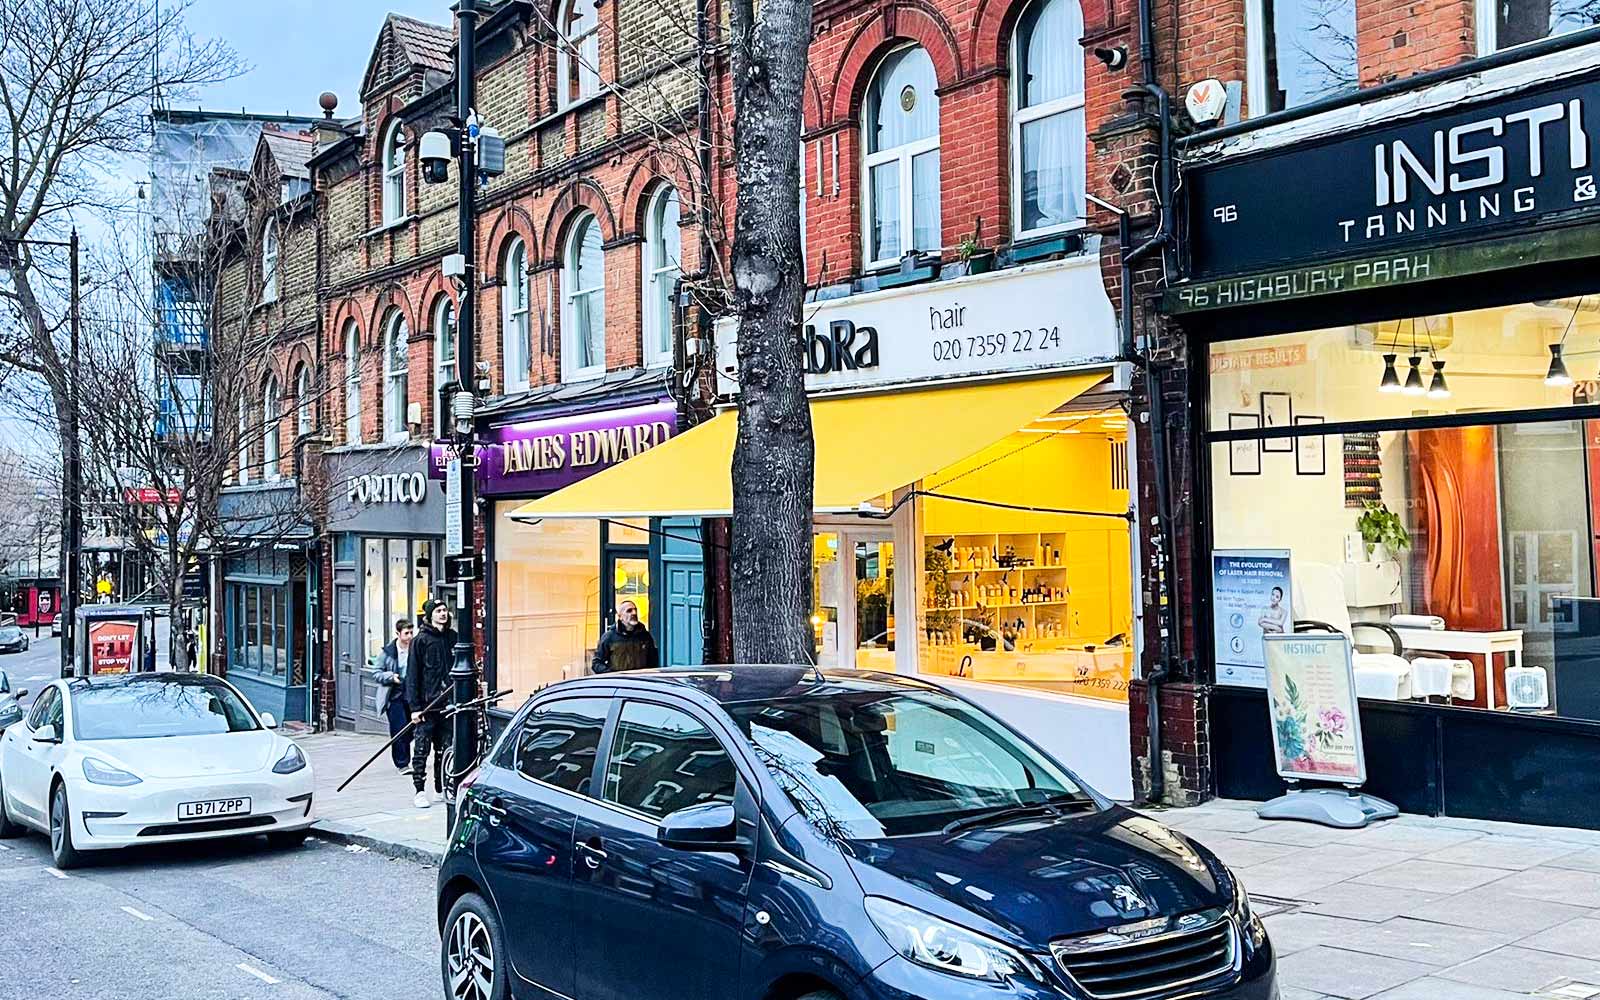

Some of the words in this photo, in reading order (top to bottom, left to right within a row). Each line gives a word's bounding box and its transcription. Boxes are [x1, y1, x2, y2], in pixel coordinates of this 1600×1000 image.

[1374, 98, 1587, 207] INSTI
[1213, 204, 1238, 223] 96
[1338, 185, 1535, 243] TANNING
[1574, 174, 1598, 202] &
[1178, 286, 1209, 308] 96
[1216, 267, 1345, 305] HIGHBURY
[929, 301, 967, 331] hair
[932, 337, 962, 362] 020
[967, 332, 1007, 358] 7359
[1012, 328, 1033, 353] 22
[1039, 325, 1061, 349] 24
[1255, 348, 1301, 366] RESULTS
[502, 433, 567, 476] JAMES
[347, 471, 427, 503] PORTICO
[1283, 642, 1328, 655] INSTINCT
[186, 802, 215, 816] LB71
[219, 800, 242, 813] ZPP
